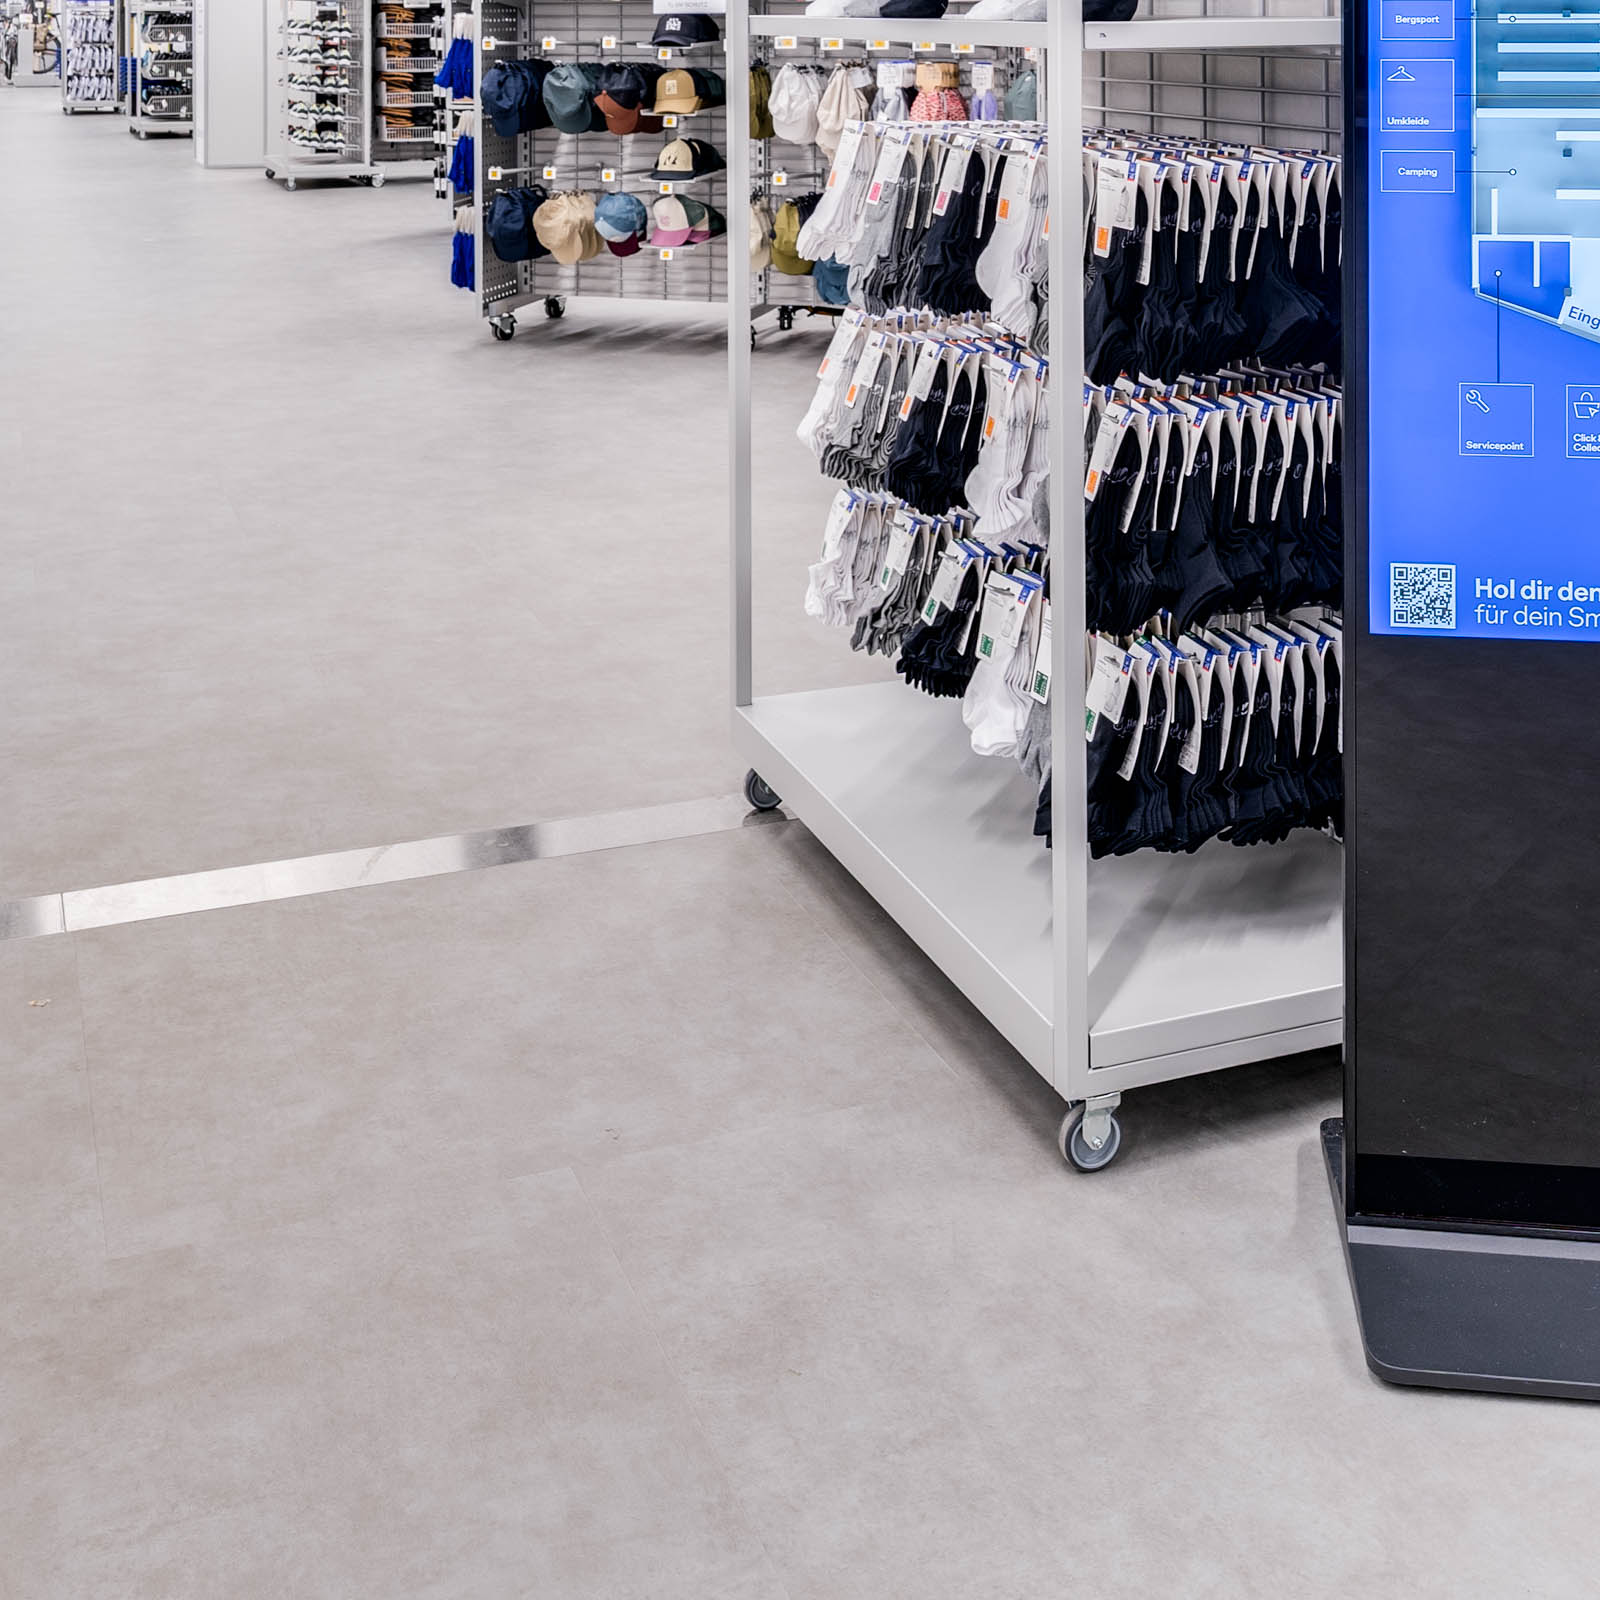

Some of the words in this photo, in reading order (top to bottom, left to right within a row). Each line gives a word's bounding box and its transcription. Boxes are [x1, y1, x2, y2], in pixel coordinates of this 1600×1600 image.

[1395, 14, 1439, 25] Bergsport
[1387, 116, 1429, 126] Umkleide
[1398, 166, 1438, 178] Camping
[1573, 433, 1596, 443] Click
[1465, 441, 1524, 451] Servicepoint
[1475, 578, 1515, 600] Hol
[1520, 579, 1552, 601] dir
[1474, 604, 1509, 625] für
[1513, 605, 1562, 627] dein
